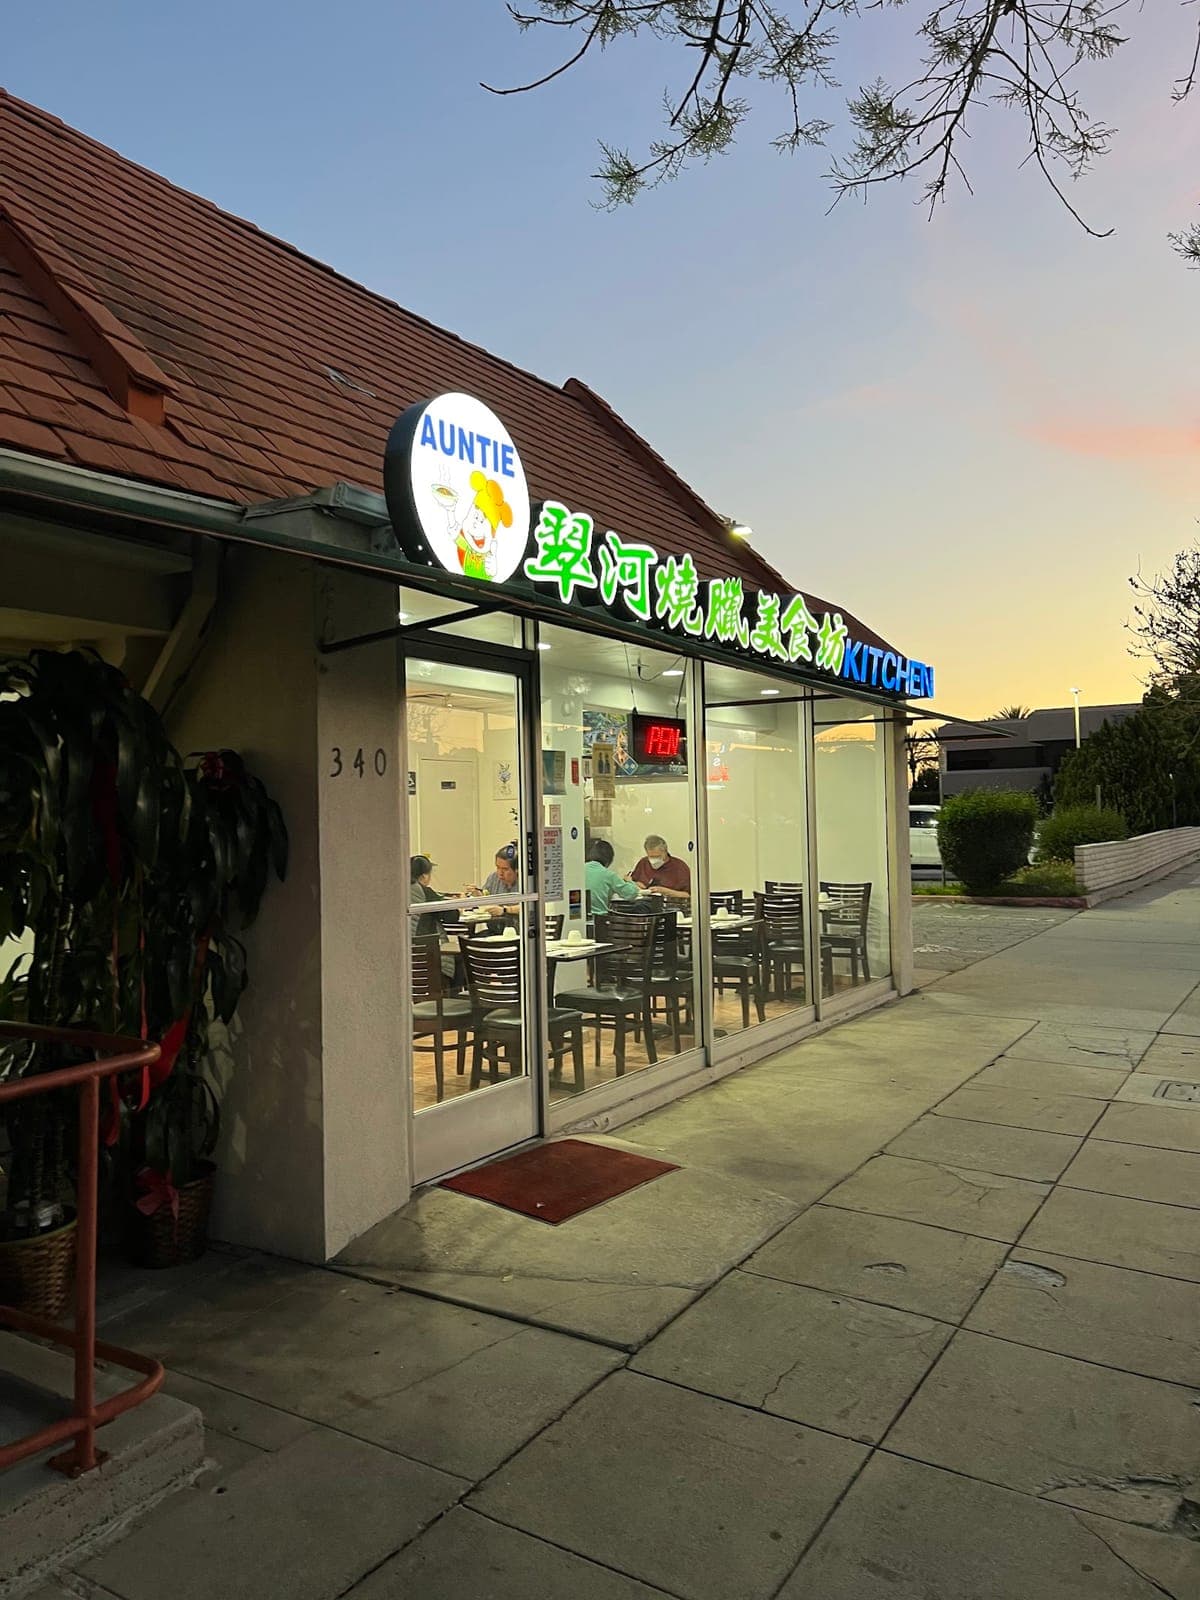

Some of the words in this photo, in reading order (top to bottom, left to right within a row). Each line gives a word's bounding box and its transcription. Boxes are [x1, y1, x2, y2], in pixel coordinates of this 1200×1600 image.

[420, 413, 515, 478] AUNTIE
[524, 501, 848, 676] 翠河燒臘美食坊
[843, 638, 935, 699] KITCHEN
[330, 747, 387, 779] 340
